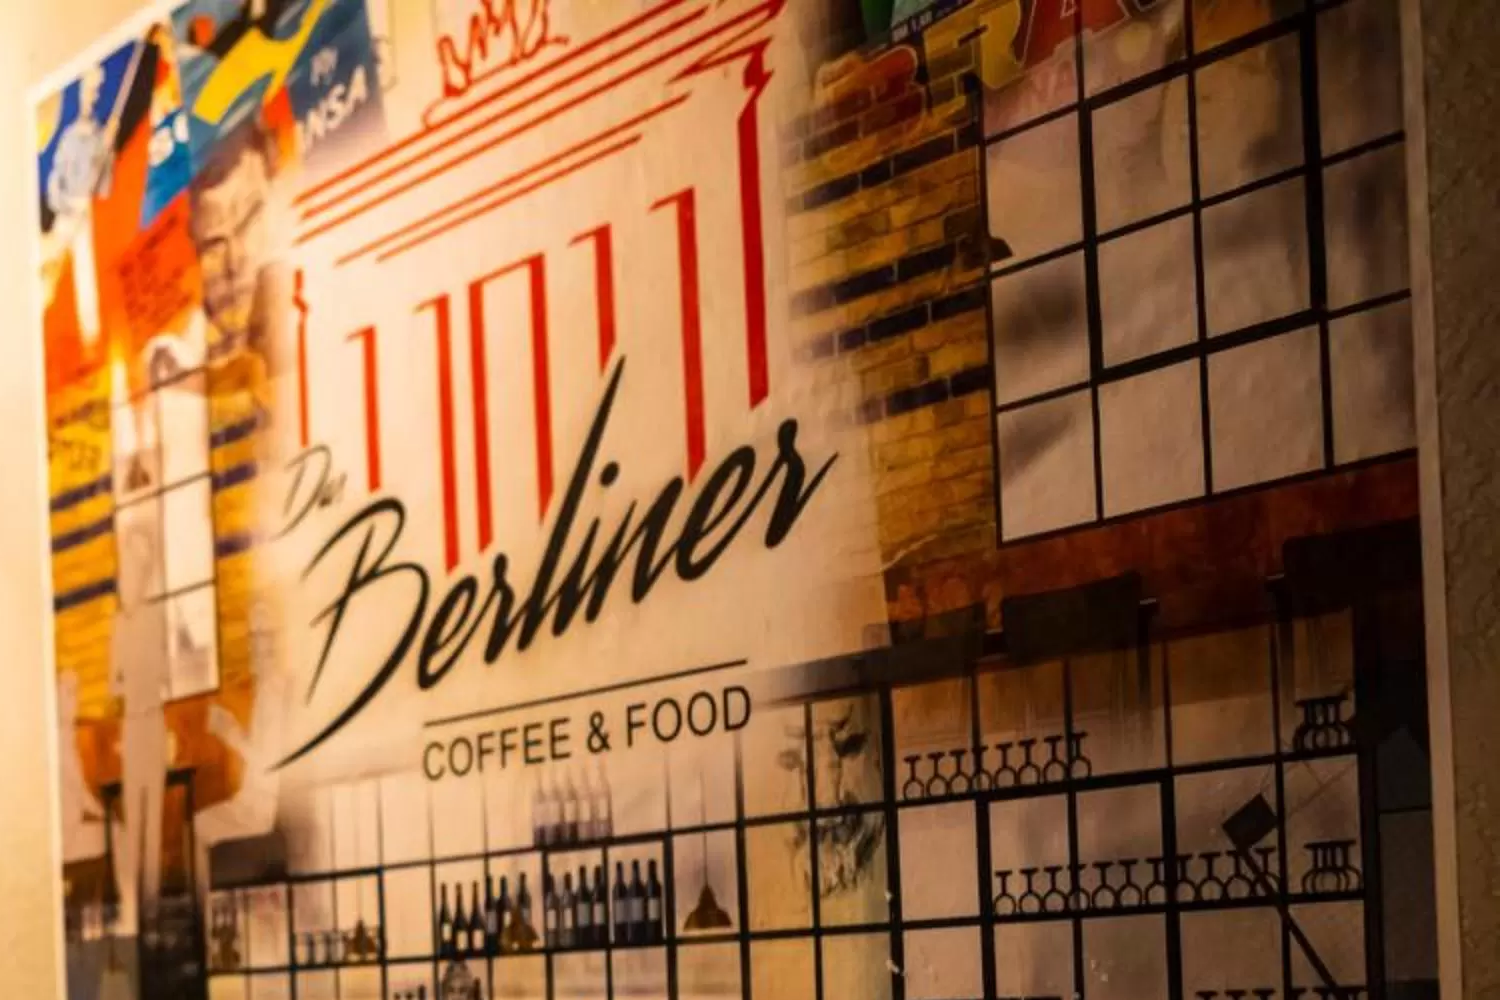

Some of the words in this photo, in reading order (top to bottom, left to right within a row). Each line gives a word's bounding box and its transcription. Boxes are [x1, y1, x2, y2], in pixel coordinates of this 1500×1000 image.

[267, 355, 839, 772] Berliner
[423, 717, 571, 781] COFFEE
[587, 711, 611, 754] &
[626, 685, 751, 748] FOOD
